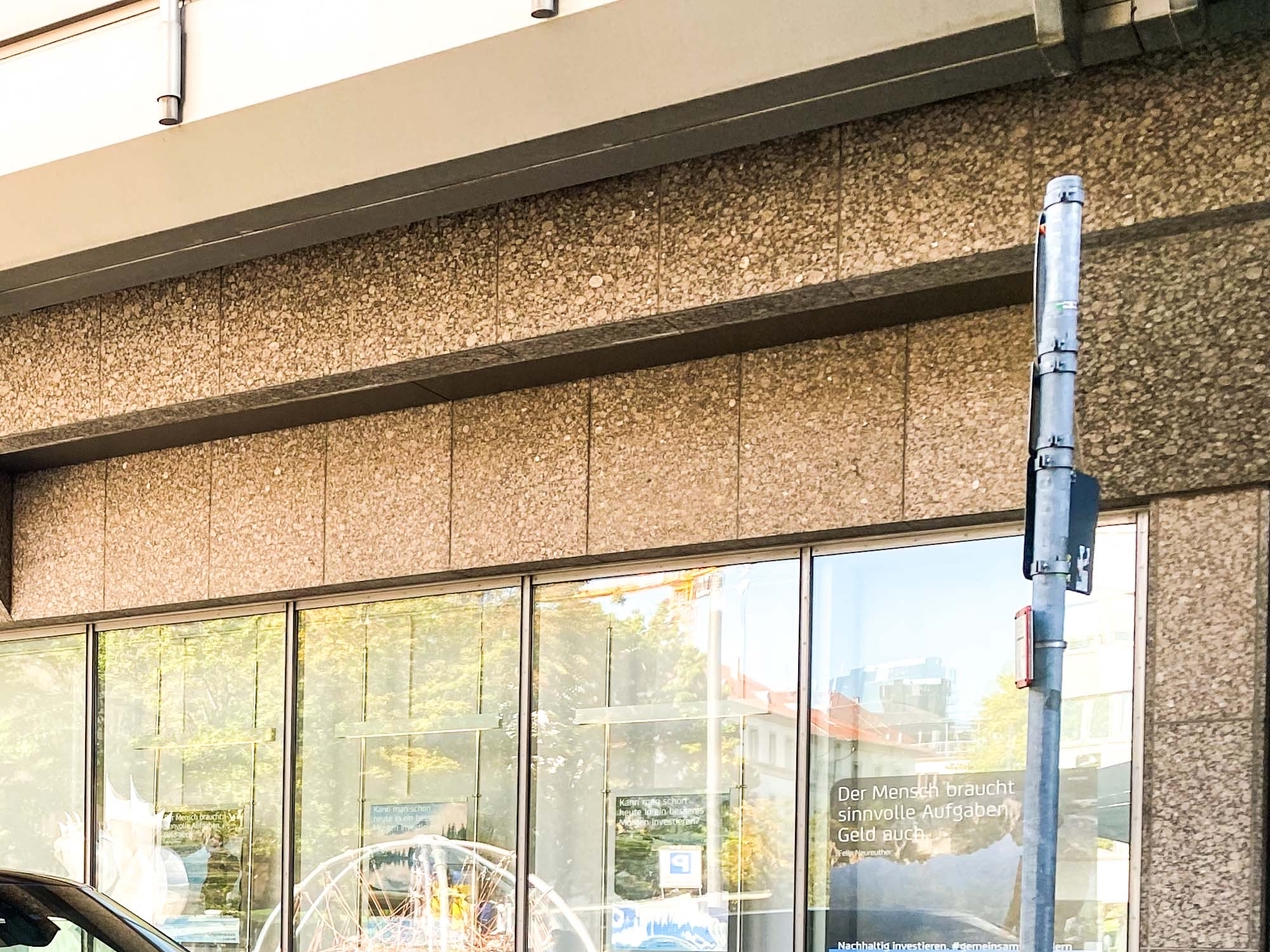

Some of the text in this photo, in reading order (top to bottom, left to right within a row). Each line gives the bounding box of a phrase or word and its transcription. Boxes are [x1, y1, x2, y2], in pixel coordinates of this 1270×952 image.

[838, 780, 1015, 801] Der Mensch braucht
[619, 796, 687, 807] Kann man schon
[619, 808, 642, 817] heute
[670, 806, 704, 815] besseres
[838, 807, 916, 822] sinnvolle
[838, 825, 927, 842] Geld auch.
[838, 941, 890, 952] Nachhaltig
[892, 941, 949, 951] investieren.
